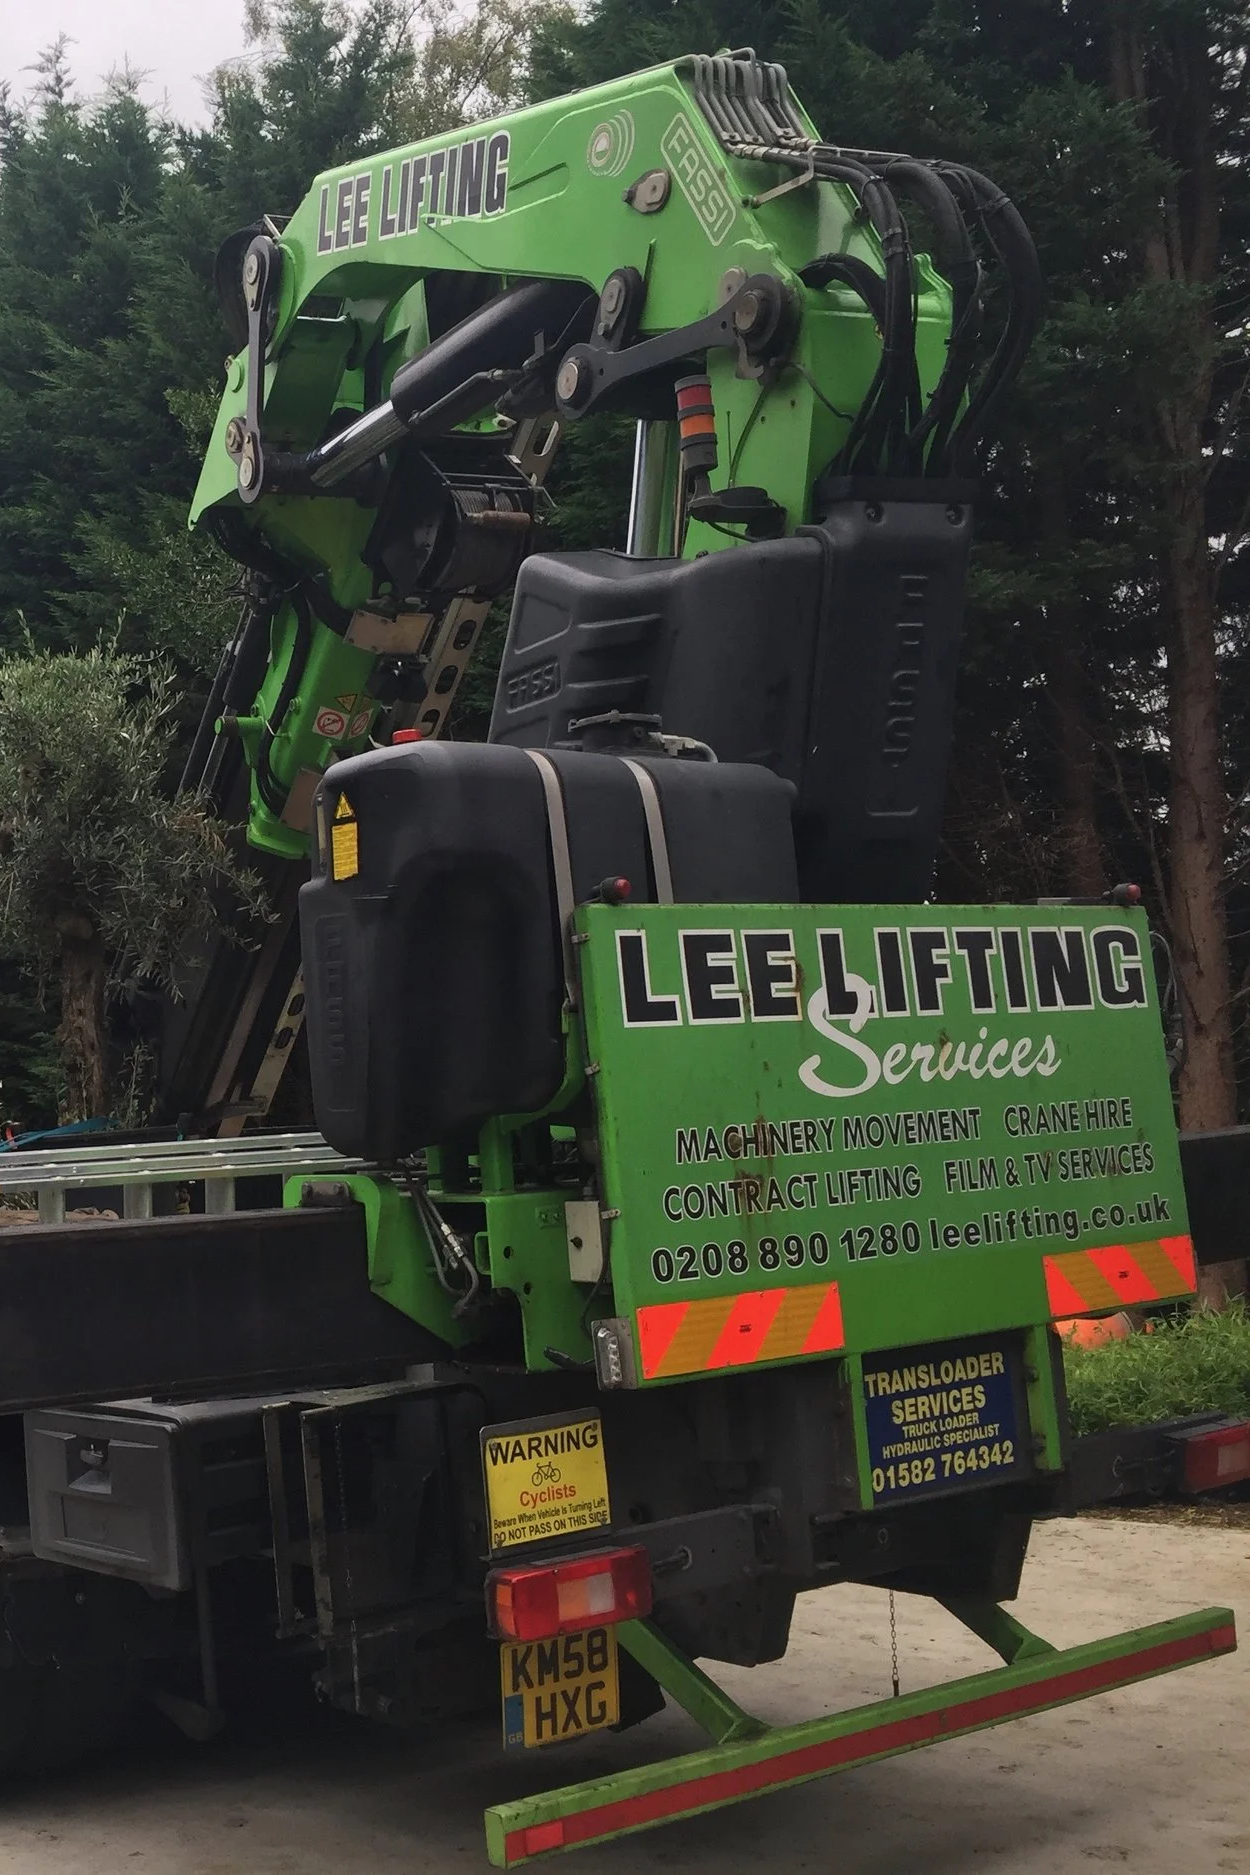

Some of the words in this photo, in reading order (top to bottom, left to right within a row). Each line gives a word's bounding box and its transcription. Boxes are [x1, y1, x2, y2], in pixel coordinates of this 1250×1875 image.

[317, 171, 372, 256] LEE
[379, 130, 510, 242] LIFTING
[667, 126, 729, 233] FASSI
[614, 928, 803, 1028] LEE
[816, 925, 1148, 1021] LIFTING
[798, 973, 1063, 1097] Services
[675, 1117, 836, 1165] MACHINERY
[842, 1107, 981, 1150] MOVEMENT
[1003, 1100, 1081, 1138] CRANE
[1084, 1097, 1133, 1131] HIRE
[663, 1173, 819, 1223] CONTRACT
[825, 1164, 922, 1207] LIFTING
[943, 1157, 1000, 1194] FILM
[1004, 1157, 1022, 1188] &
[1023, 1151, 1053, 1185] TV
[1057, 1142, 1155, 1182] SERVICES
[651, 1239, 750, 1284] 0208
[758, 1231, 830, 1272] 890
[838, 1220, 922, 1262] 1280
[928, 1192, 1171, 1250] leelifting.co.uk
[864, 1352, 1005, 1398] TRANSLOADER
[891, 1384, 986, 1425] SERVICES
[902, 1419, 937, 1438] TRUCK
[940, 1412, 979, 1430] LOADER
[488, 1425, 598, 1466] WARNING
[872, 1457, 936, 1493] 01582
[941, 1440, 1014, 1477] 764342
[882, 1437, 941, 1459] HYDRAULIC
[943, 1423, 999, 1447] SPECIALIST
[493, 1516, 517, 1530] Beware
[517, 1512, 537, 1523] When
[537, 1507, 560, 1520] Vehicle
[561, 1505, 567, 1515] Is
[568, 1501, 592, 1513] Turning
[593, 1498, 606, 1509] Left
[519, 1484, 577, 1509] Cyclists
[494, 1531, 507, 1544] DO
[508, 1527, 527, 1541] NOT
[529, 1522, 552, 1536] PASS
[553, 1519, 566, 1531] ON
[569, 1514, 587, 1526] THIS
[589, 1510, 608, 1523] SIDE
[511, 1628, 609, 1693] KM58
[535, 1680, 607, 1740] HXG
[508, 1732, 523, 1744] GB
